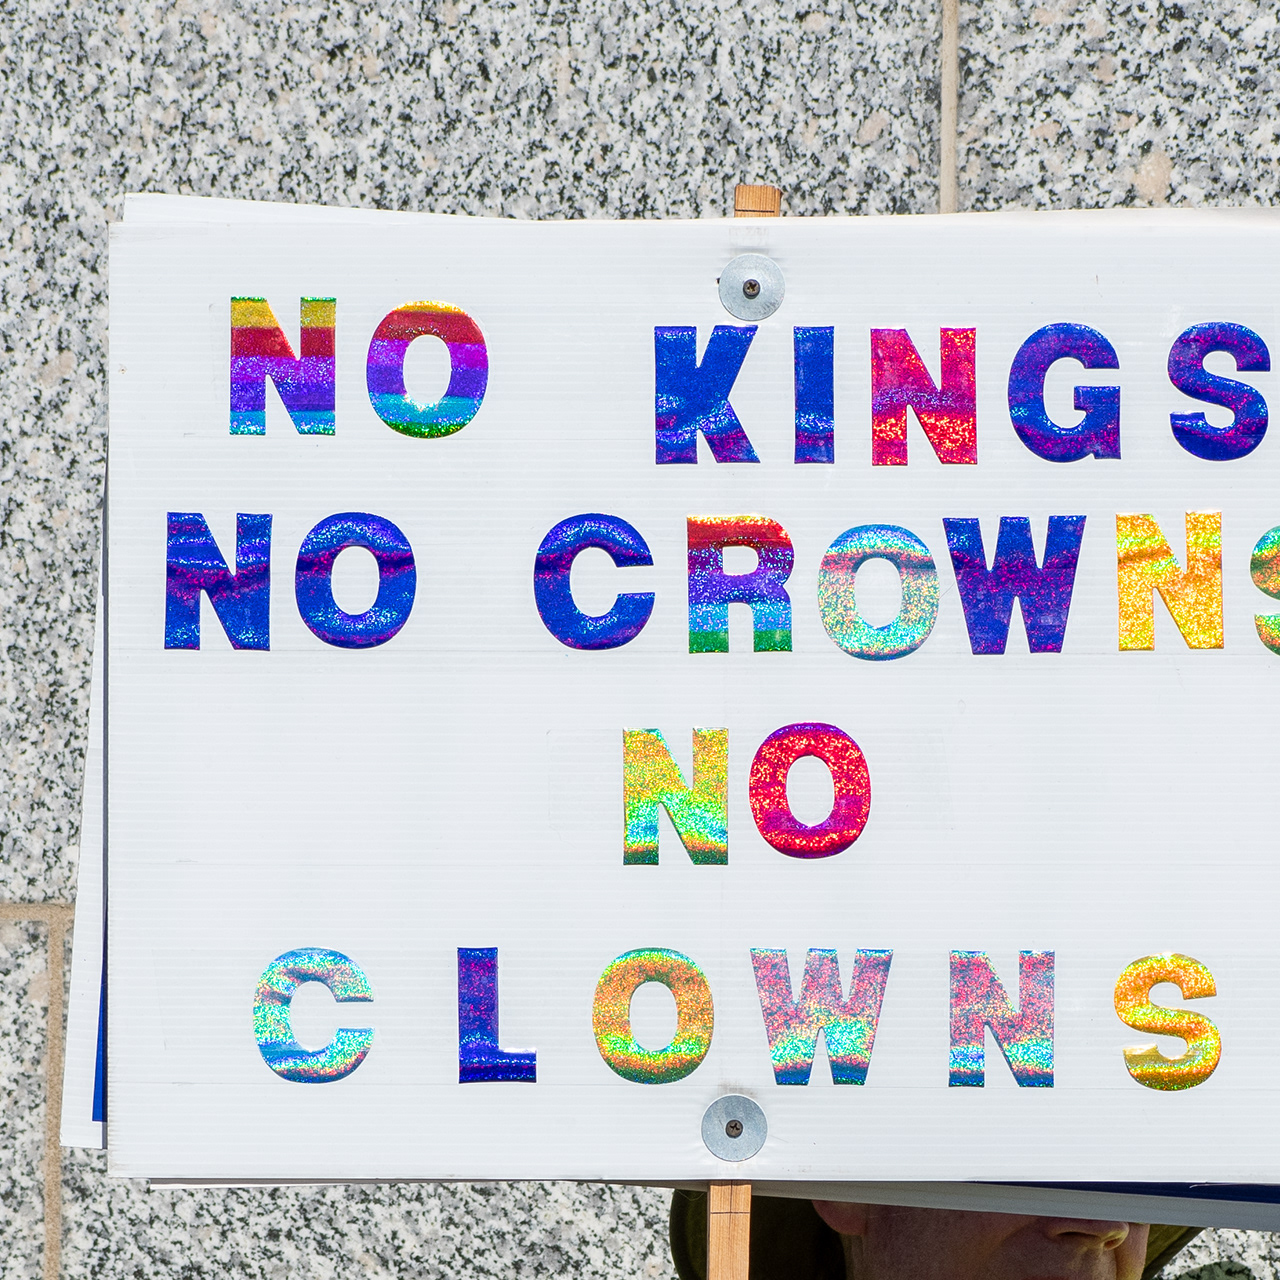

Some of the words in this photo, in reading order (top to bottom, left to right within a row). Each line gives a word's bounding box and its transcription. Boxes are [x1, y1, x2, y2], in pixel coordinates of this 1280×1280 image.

[229, 296, 490, 439] NO
[653, 321, 1272, 466] KINGS
[163, 511, 418, 652] NO
[622, 721, 872, 867] NO
[252, 946, 1223, 1091] CLOWNS
